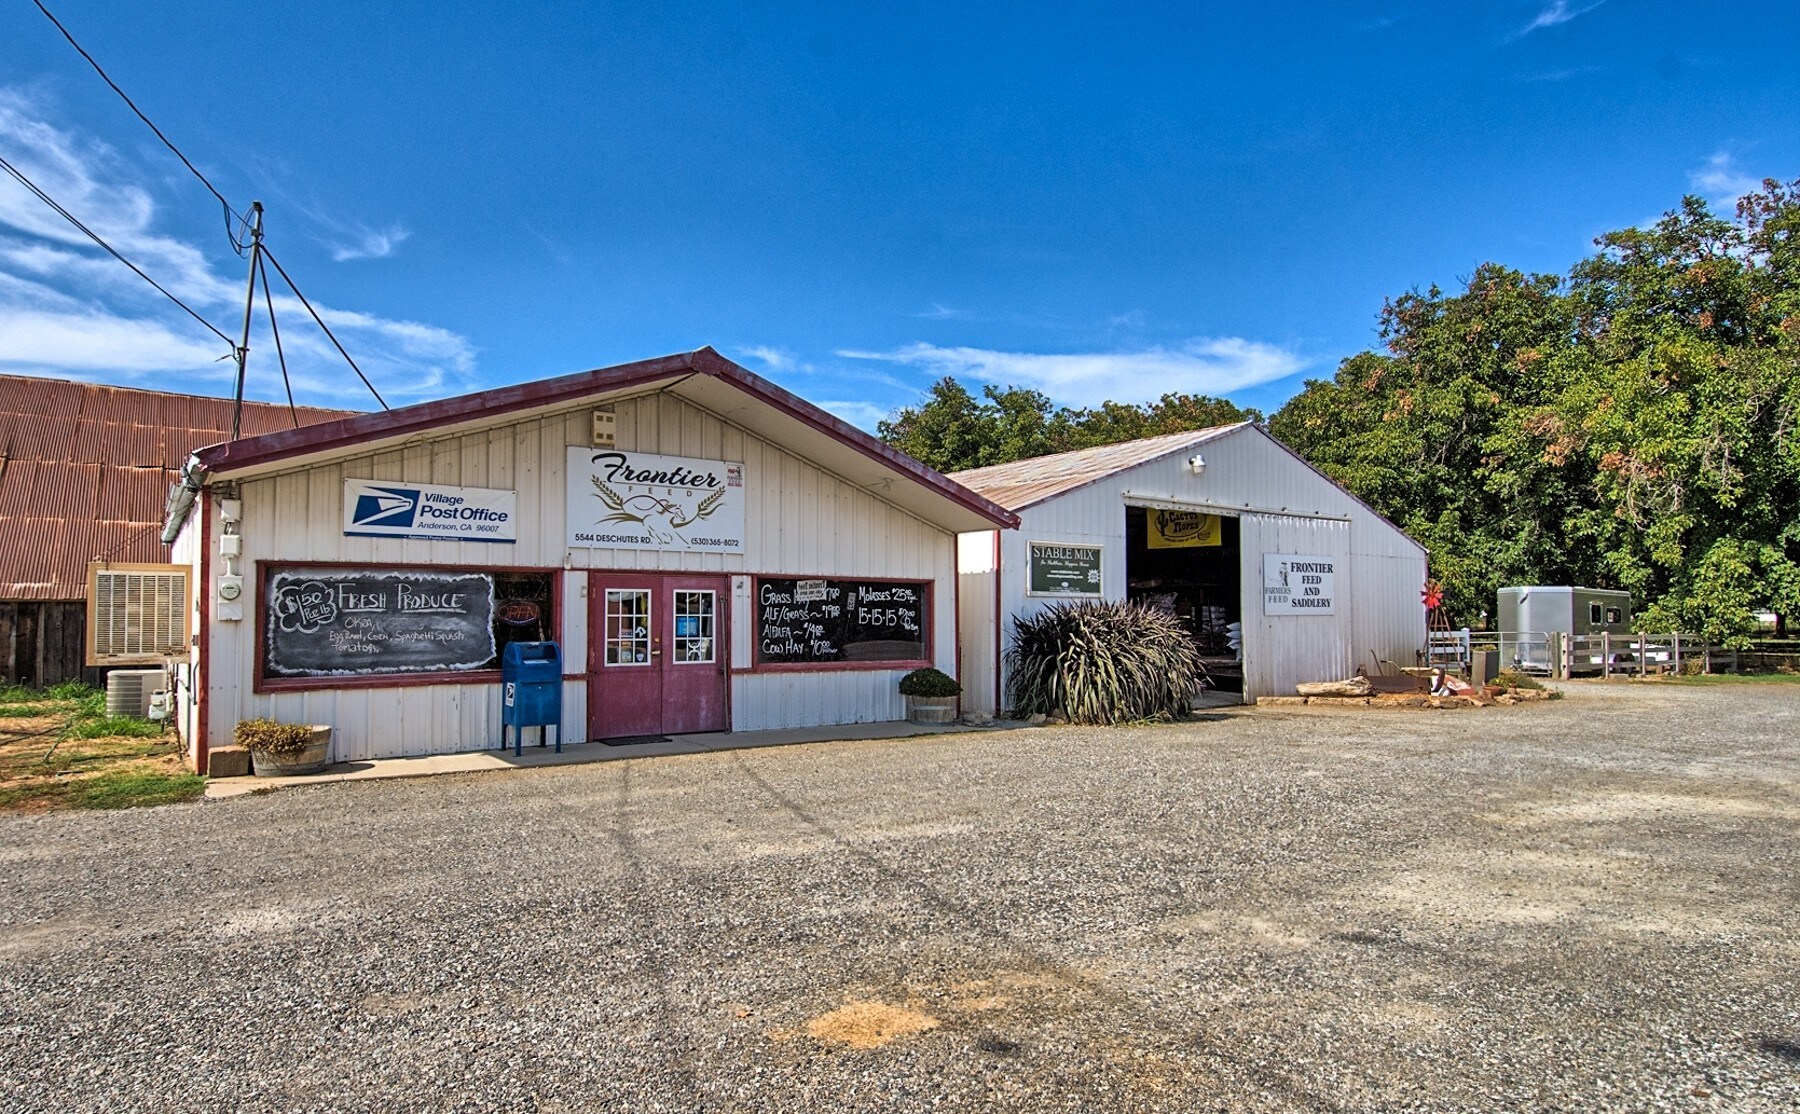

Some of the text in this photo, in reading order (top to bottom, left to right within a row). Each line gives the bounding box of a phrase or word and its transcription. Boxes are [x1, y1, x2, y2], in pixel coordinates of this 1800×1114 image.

[592, 453, 721, 488] Frontier
[628, 486, 693, 497] FEED
[425, 493, 464, 506] Village
[420, 505, 508, 522] Post Office
[417, 521, 458, 531] Anderson,
[460, 523, 472, 531] CA
[575, 534, 594, 542] 5544
[596, 534, 639, 544] DESCHUTES
[1033, 546, 1094, 561] STABLE MIX
[1291, 562, 1334, 574] FRONTIER
[1302, 575, 1322, 584] FEED
[1303, 587, 1320, 596] AND
[1268, 595, 1288, 603] FEED
[1291, 598, 1331, 607] SADDLERY
[498, 604, 537, 619] OPEN
